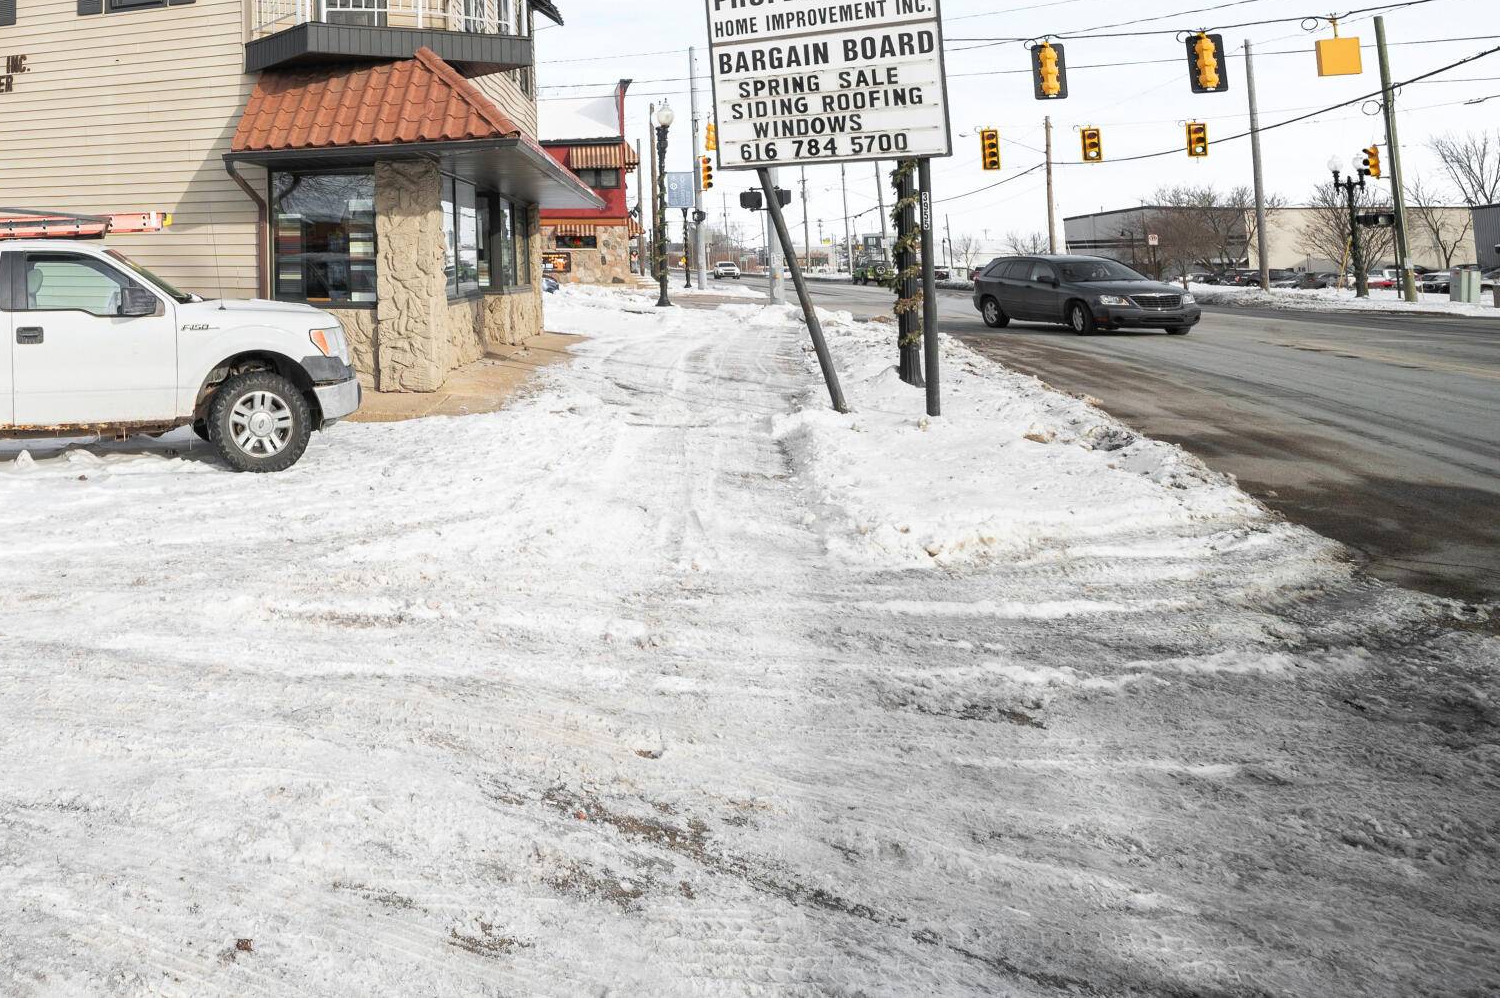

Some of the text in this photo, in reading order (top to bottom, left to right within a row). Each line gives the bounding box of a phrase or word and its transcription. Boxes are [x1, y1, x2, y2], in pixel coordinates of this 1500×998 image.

[715, 17, 758, 38] HOME
[766, 0, 886, 31] IMPROVEMENT
[6, 54, 31, 74] INC.
[719, 31, 934, 74] BARGAIN BOARD
[739, 67, 898, 98] SPRING SALE
[732, 87, 923, 120] SIDING ROOFING
[753, 114, 862, 139] WINDOWS
[740, 133, 908, 161] 616 784 5700
